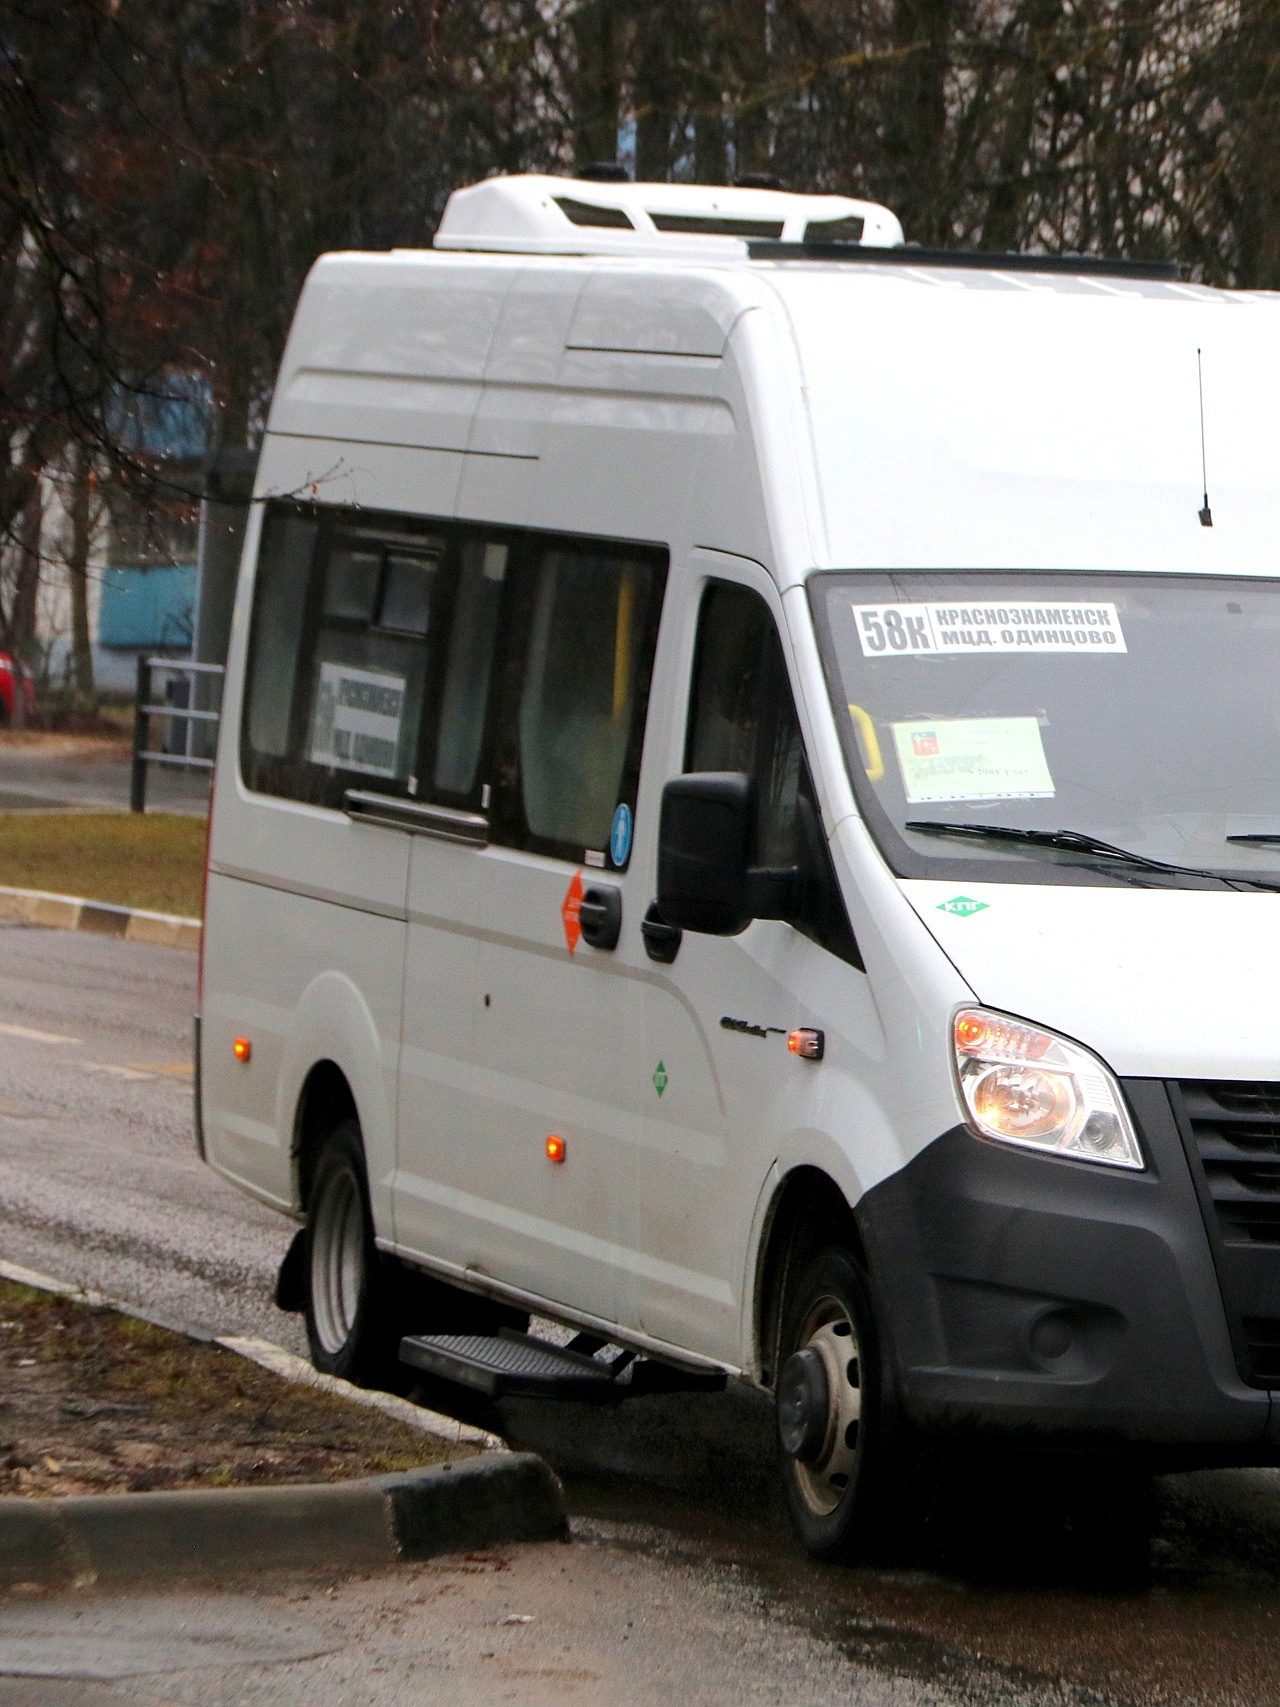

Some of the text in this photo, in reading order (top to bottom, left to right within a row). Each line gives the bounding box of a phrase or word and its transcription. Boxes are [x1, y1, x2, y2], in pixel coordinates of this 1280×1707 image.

[935, 608, 1112, 626] КРАСНОЗНАМЕНСК
[940, 629, 1117, 646] МЦД. ОДИНЦОВО
